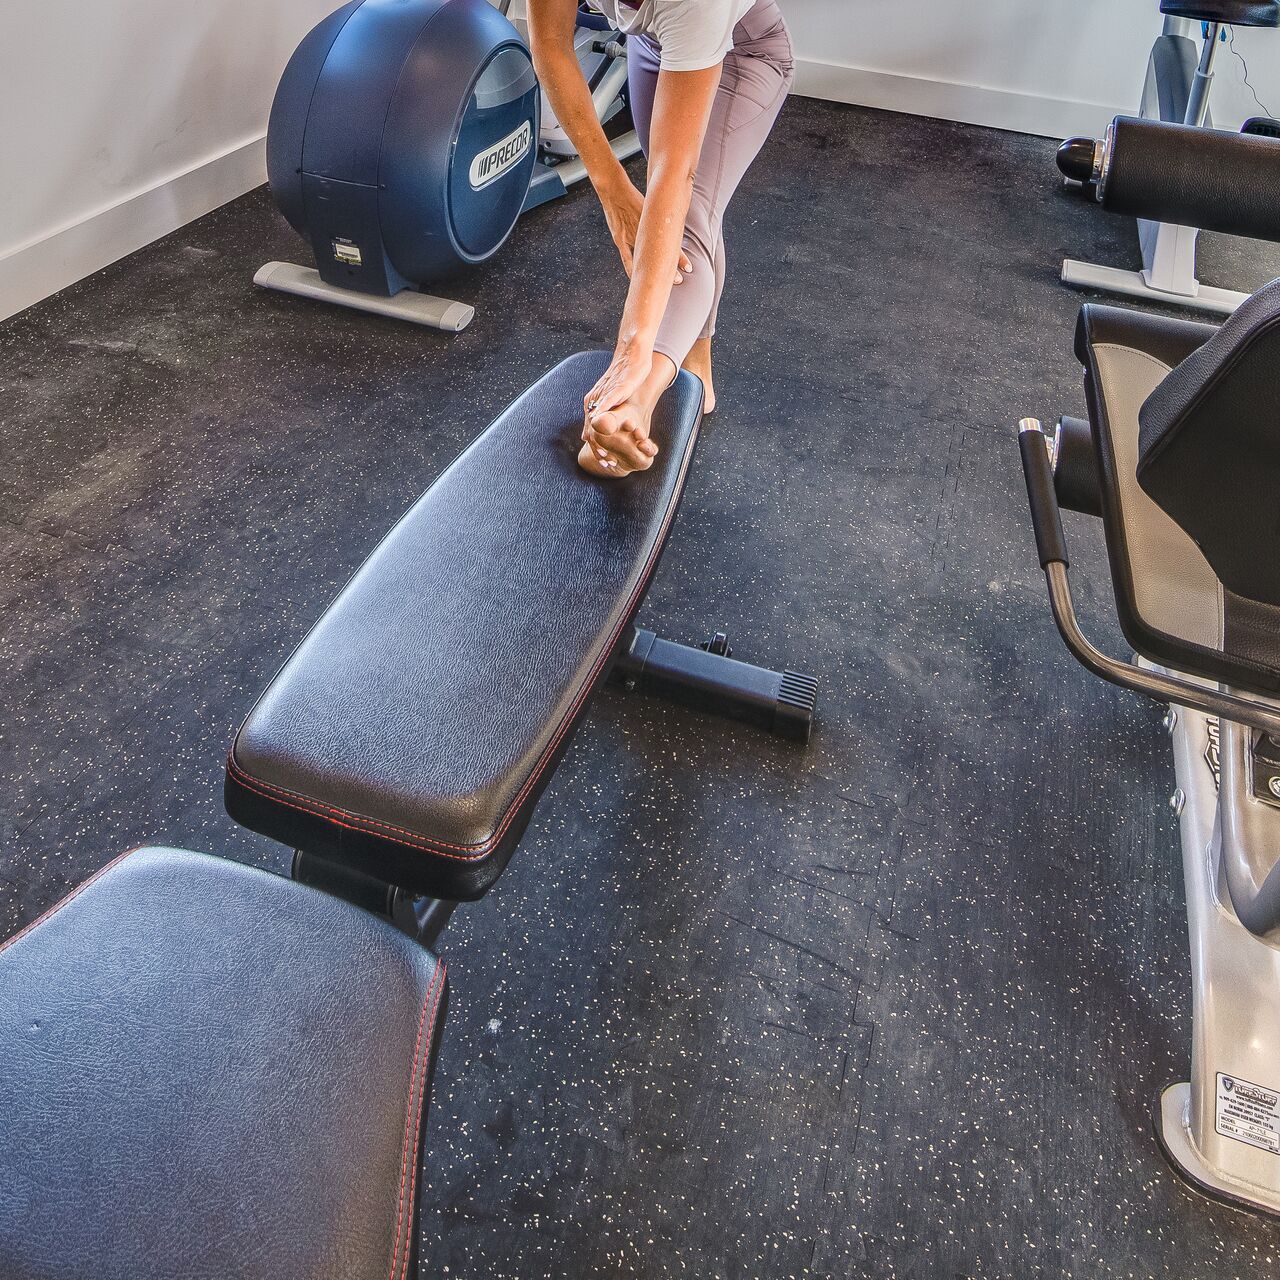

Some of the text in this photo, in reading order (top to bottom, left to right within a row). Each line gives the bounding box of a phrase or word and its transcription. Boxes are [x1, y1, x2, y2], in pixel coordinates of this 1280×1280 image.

[484, 128, 528, 174] PRECOR
[1220, 1116, 1235, 1124] MODEL
[1220, 1123, 1234, 1131] SERIAL
